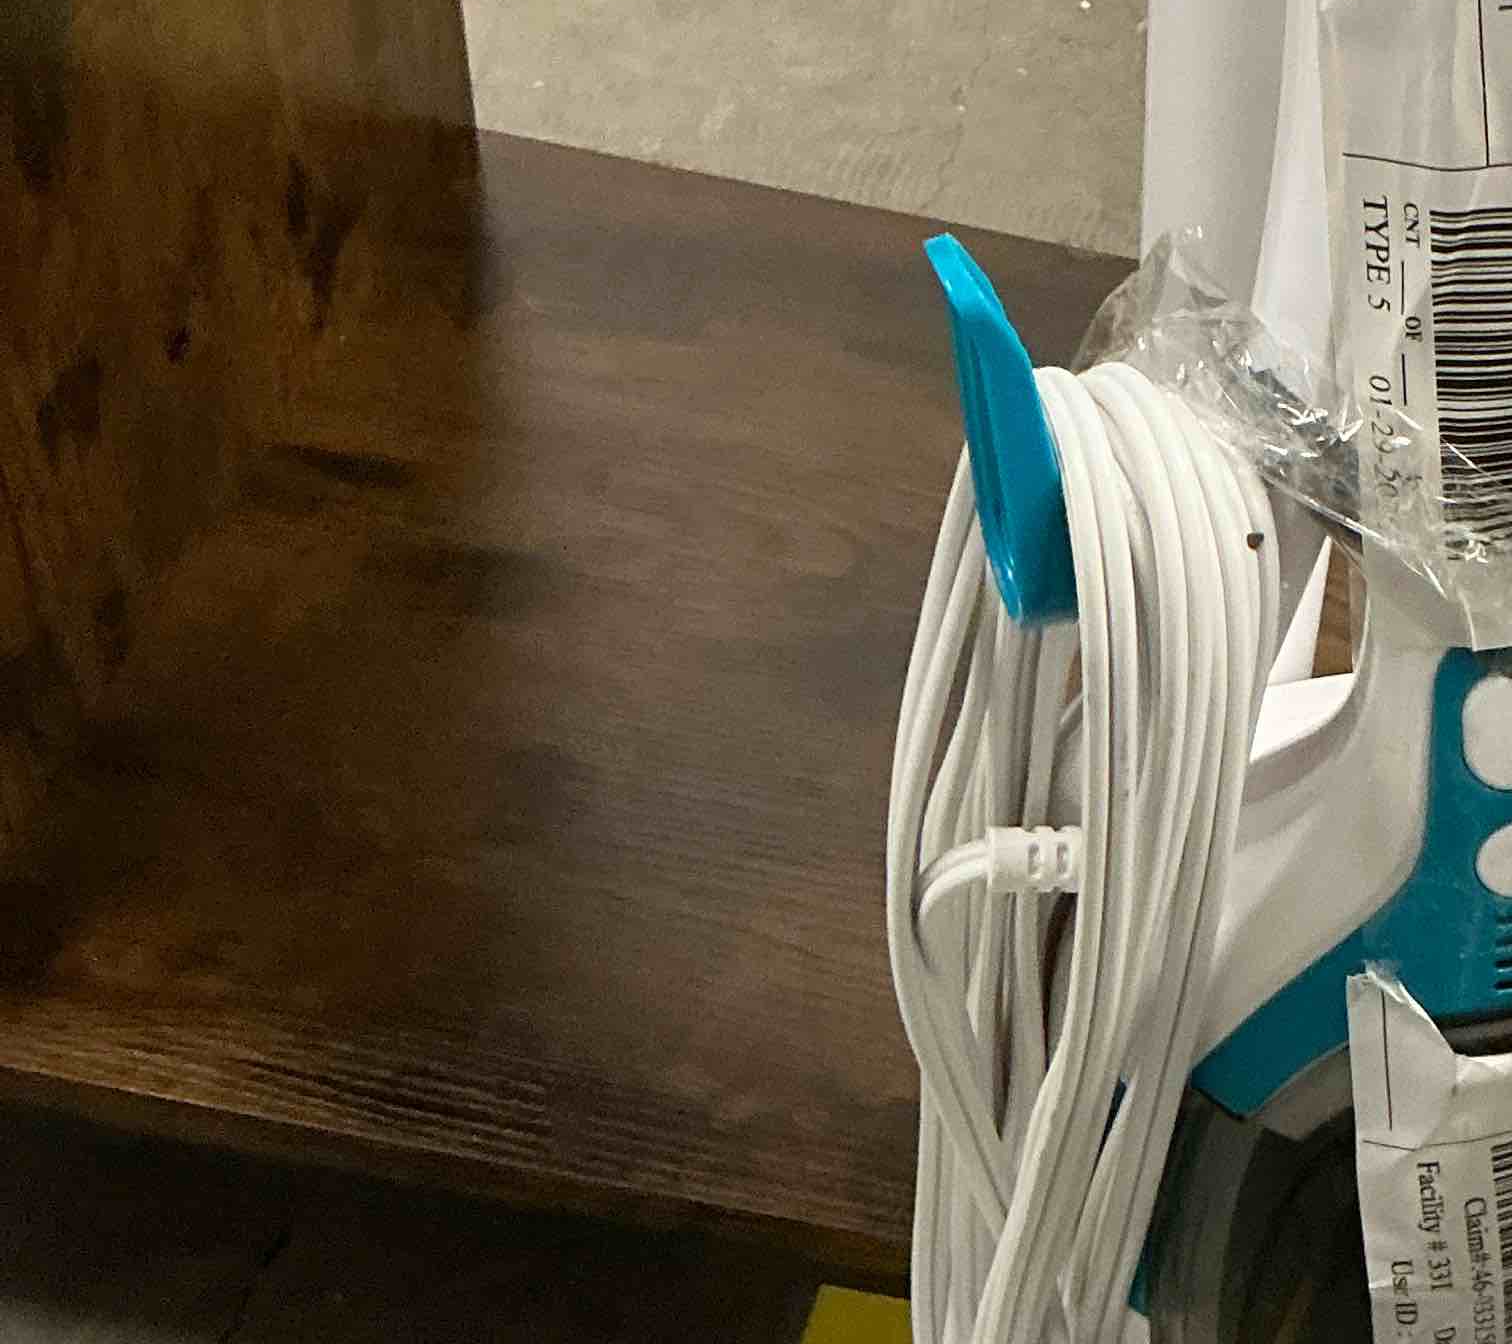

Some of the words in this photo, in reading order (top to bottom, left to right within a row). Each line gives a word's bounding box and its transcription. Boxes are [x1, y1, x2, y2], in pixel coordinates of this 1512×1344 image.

[1362, 194, 1392, 285] TYPE
[1402, 202, 1421, 248] CNT
[1367, 293, 1391, 313] 5
[1403, 315, 1423, 344] OF
[1416, 1160, 1445, 1233] Facility
[1425, 1240, 1448, 1252] #
[1427, 1257, 1454, 1291] 331
[1395, 1302, 1419, 1326] ID
